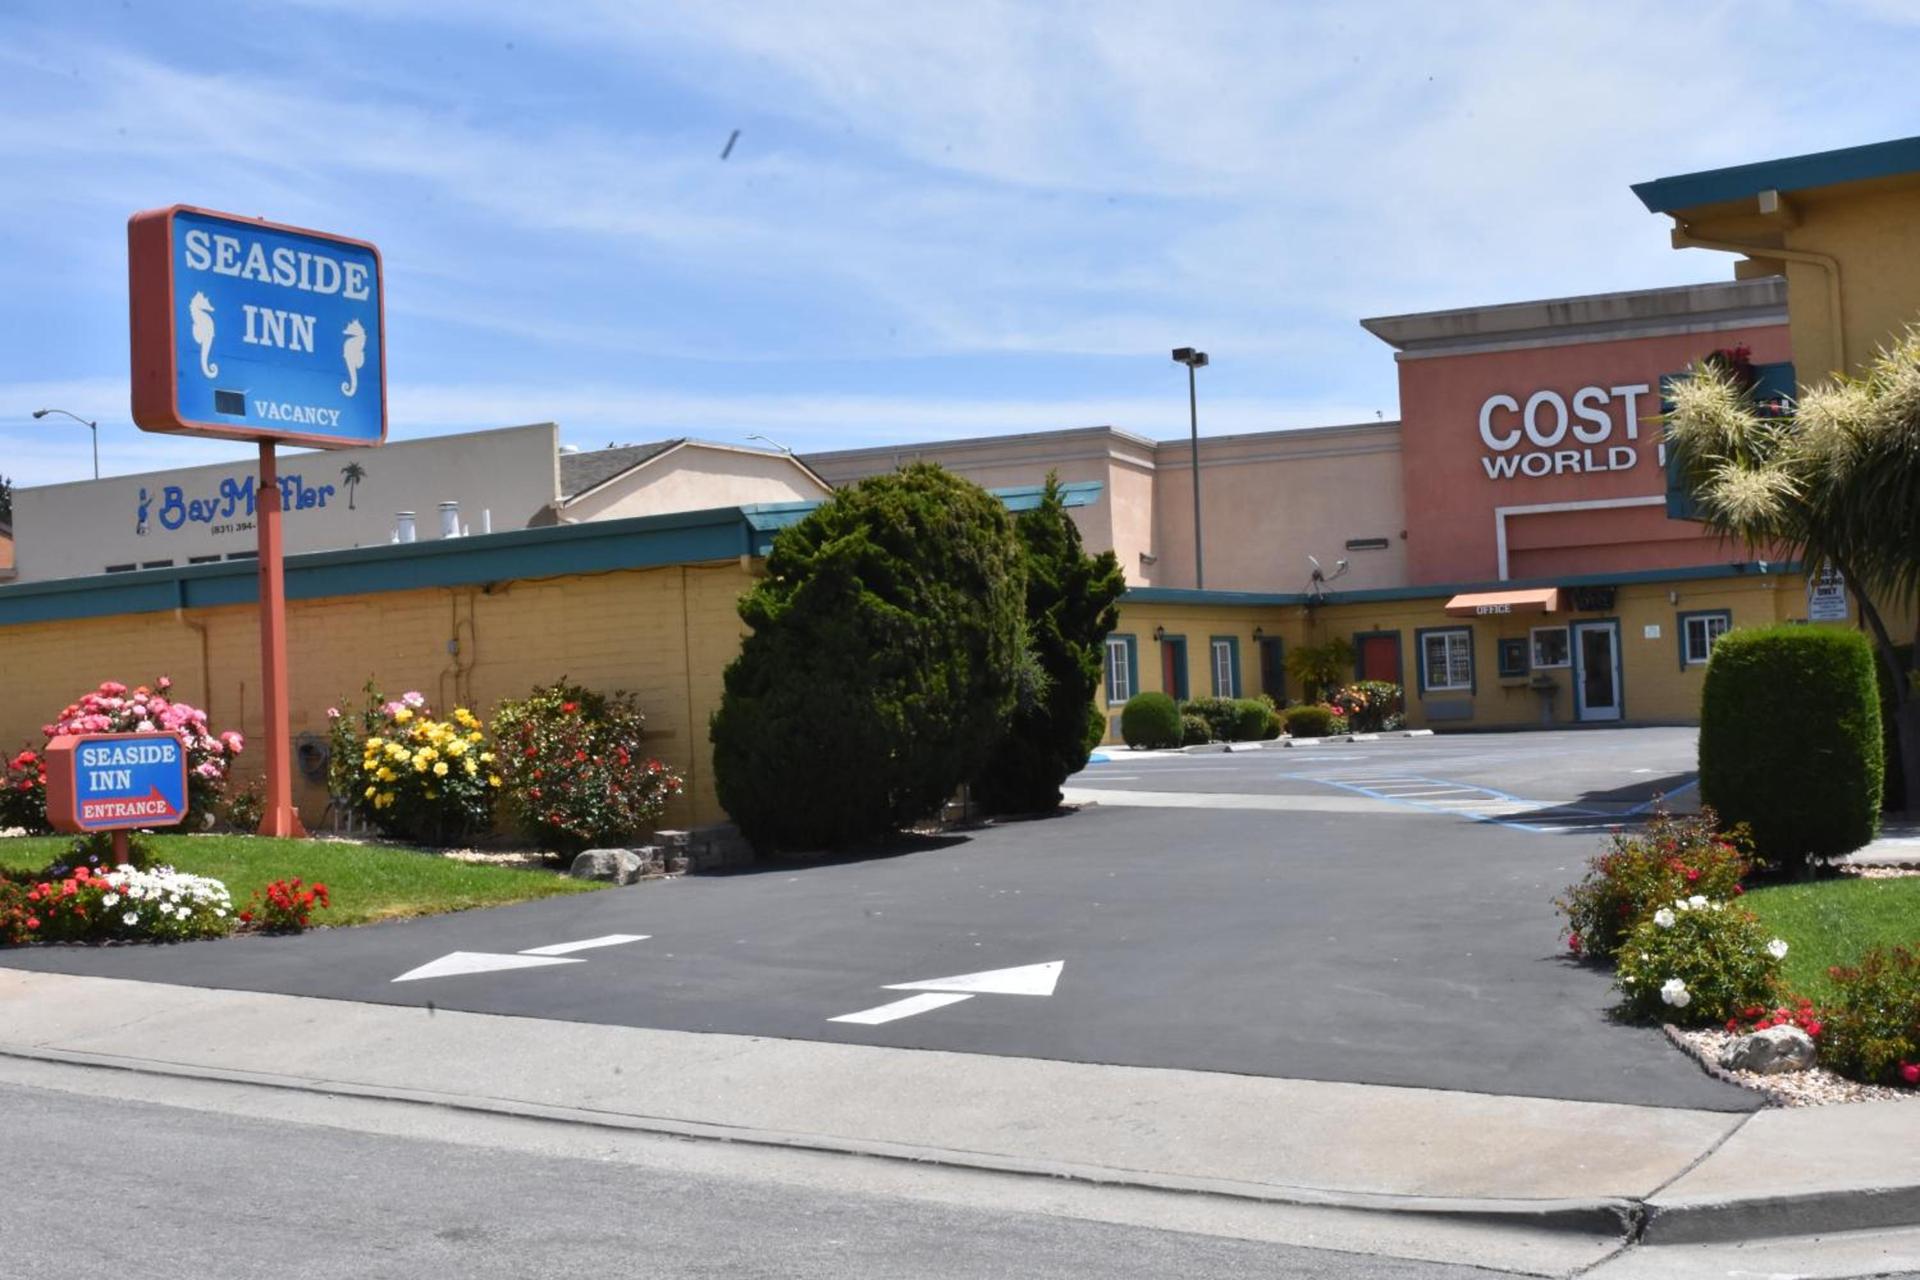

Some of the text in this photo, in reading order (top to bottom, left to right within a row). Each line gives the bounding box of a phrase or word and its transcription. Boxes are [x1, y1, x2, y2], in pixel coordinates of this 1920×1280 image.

[185, 229, 369, 301] SEASIDE
[243, 304, 317, 353] INN
[254, 400, 340, 427] VACANCY
[1479, 384, 1649, 451] COST
[1482, 446, 1637, 480] WORLD
[159, 475, 335, 530] Bay Mfler
[211, 523, 234, 536] (831)
[1476, 604, 1512, 615] OFFICE
[83, 745, 176, 767] SEASIDE
[89, 769, 132, 791] INN
[83, 800, 167, 819] ENTRANCE
